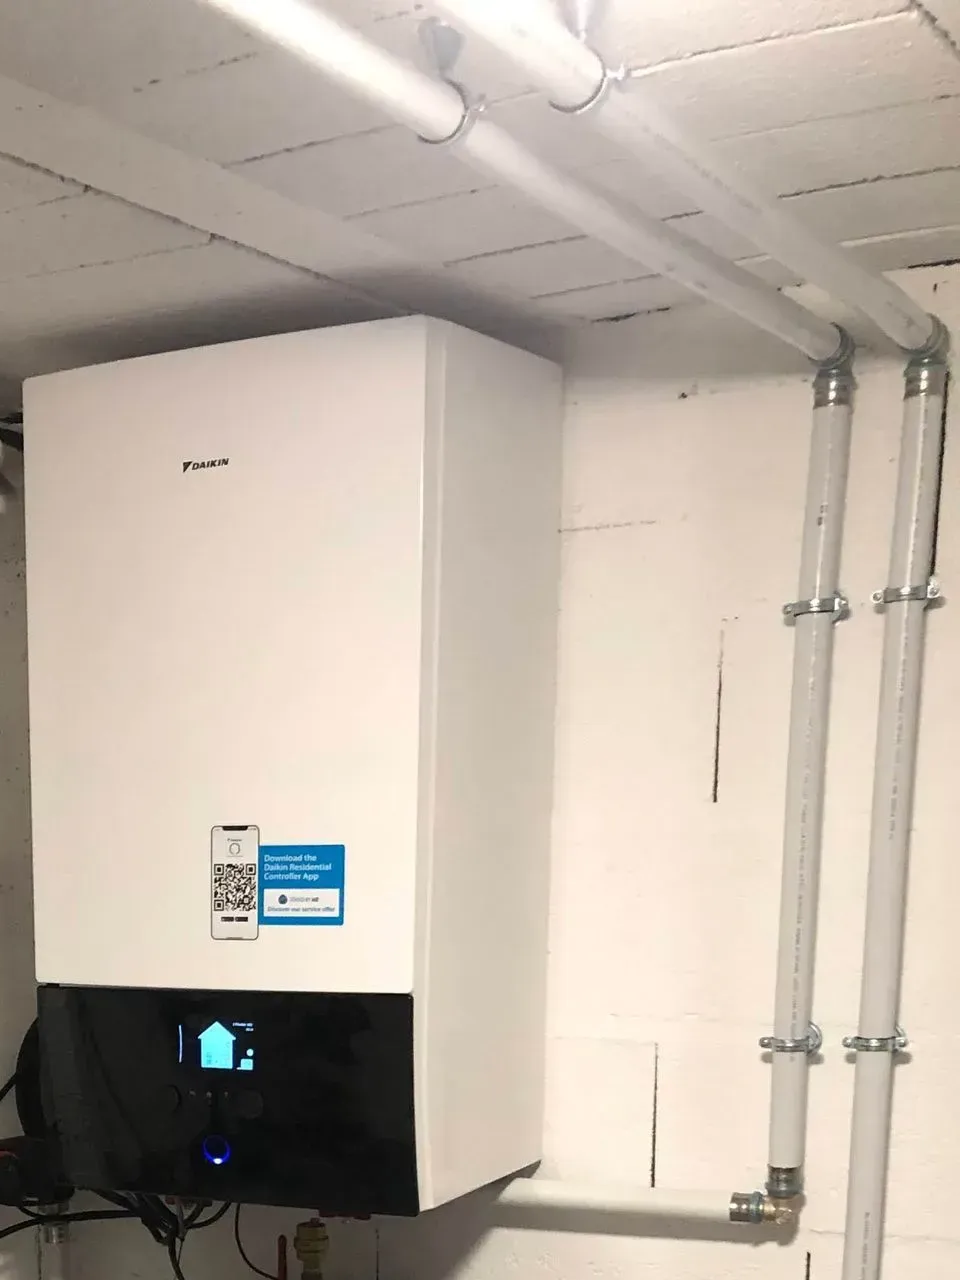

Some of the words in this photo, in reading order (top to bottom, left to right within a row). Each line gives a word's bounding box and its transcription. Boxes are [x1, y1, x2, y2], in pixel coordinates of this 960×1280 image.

[192, 458, 230, 471] DAIKIN
[264, 854, 303, 862] Download
[304, 854, 317, 862] the
[264, 863, 288, 871] Daikin
[289, 863, 332, 871] Residential
[264, 872, 301, 880] Controller
[302, 872, 320, 882] App
